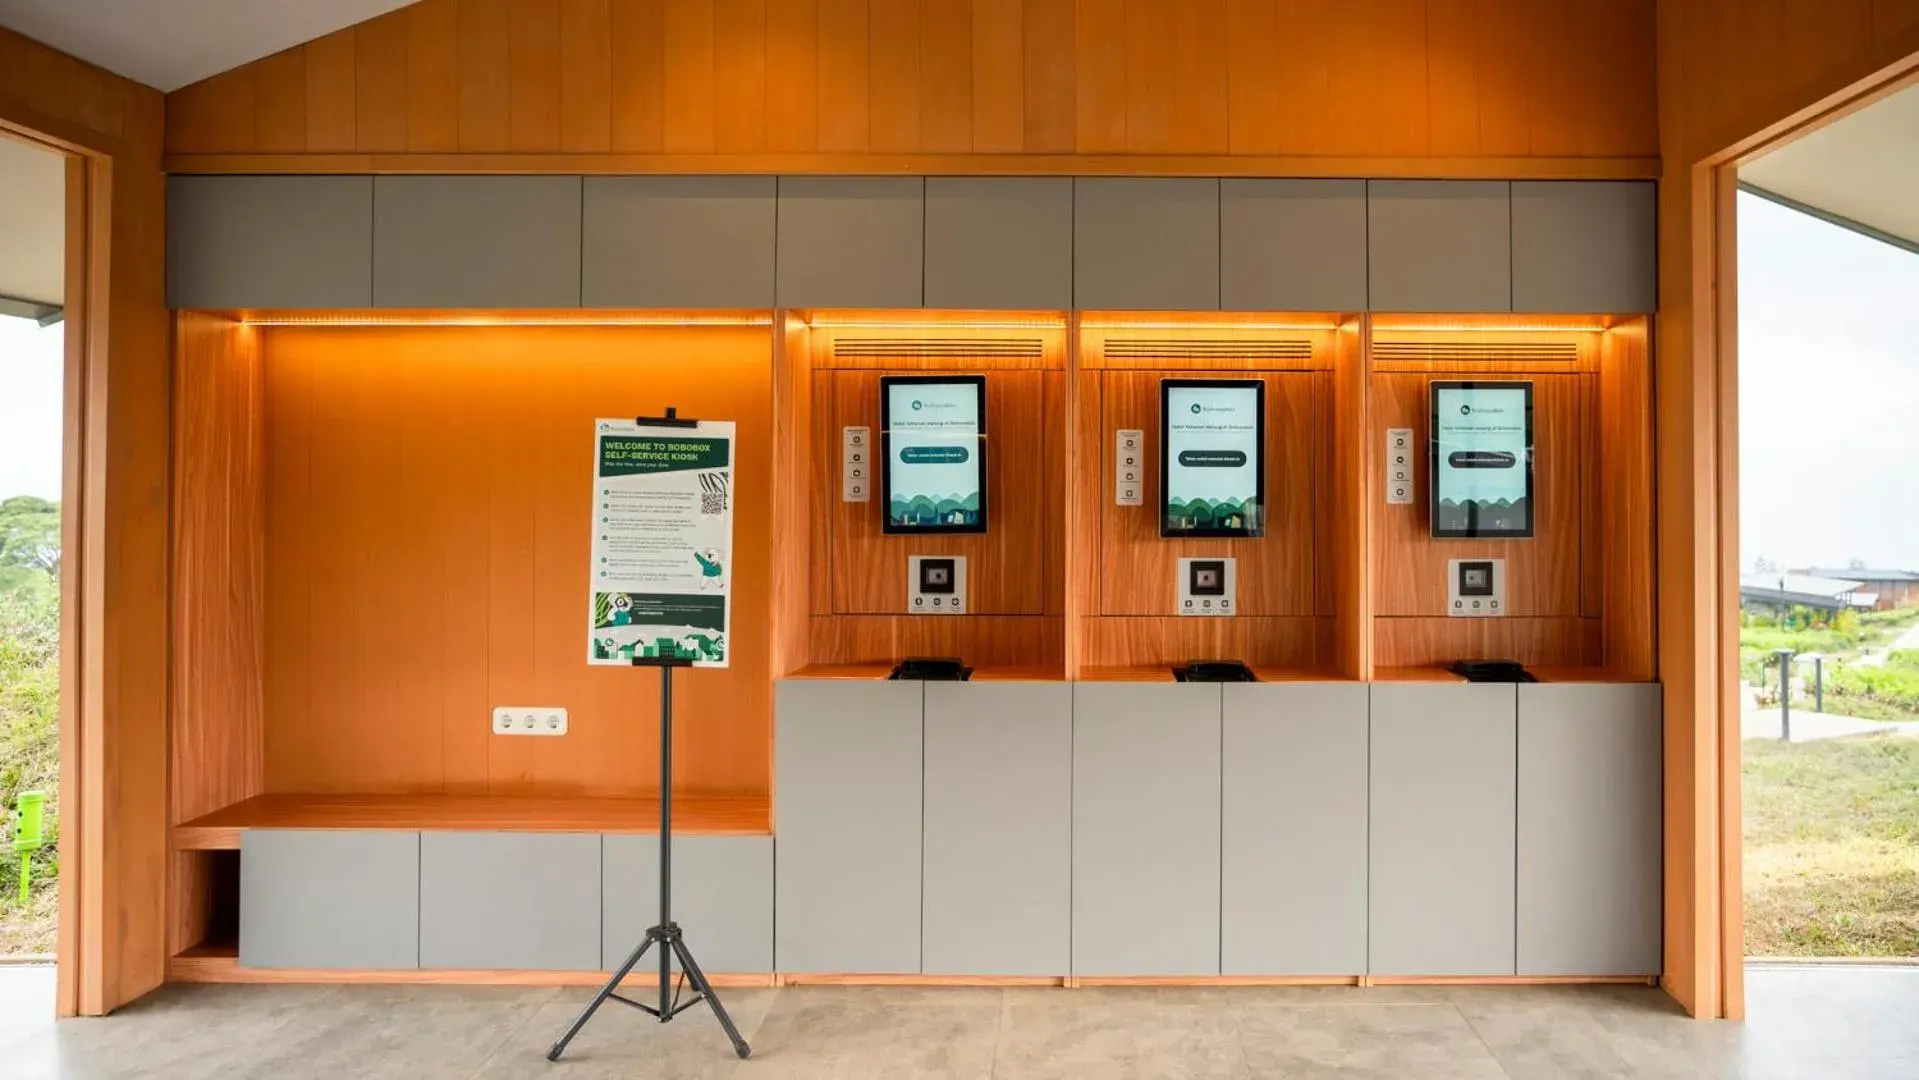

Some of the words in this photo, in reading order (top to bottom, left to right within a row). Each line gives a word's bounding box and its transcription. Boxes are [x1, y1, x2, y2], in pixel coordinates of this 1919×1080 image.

[605, 442, 651, 450] WELCOME
[668, 443, 710, 452] BOBOBOX
[605, 451, 669, 460] SELF-SERVICE
